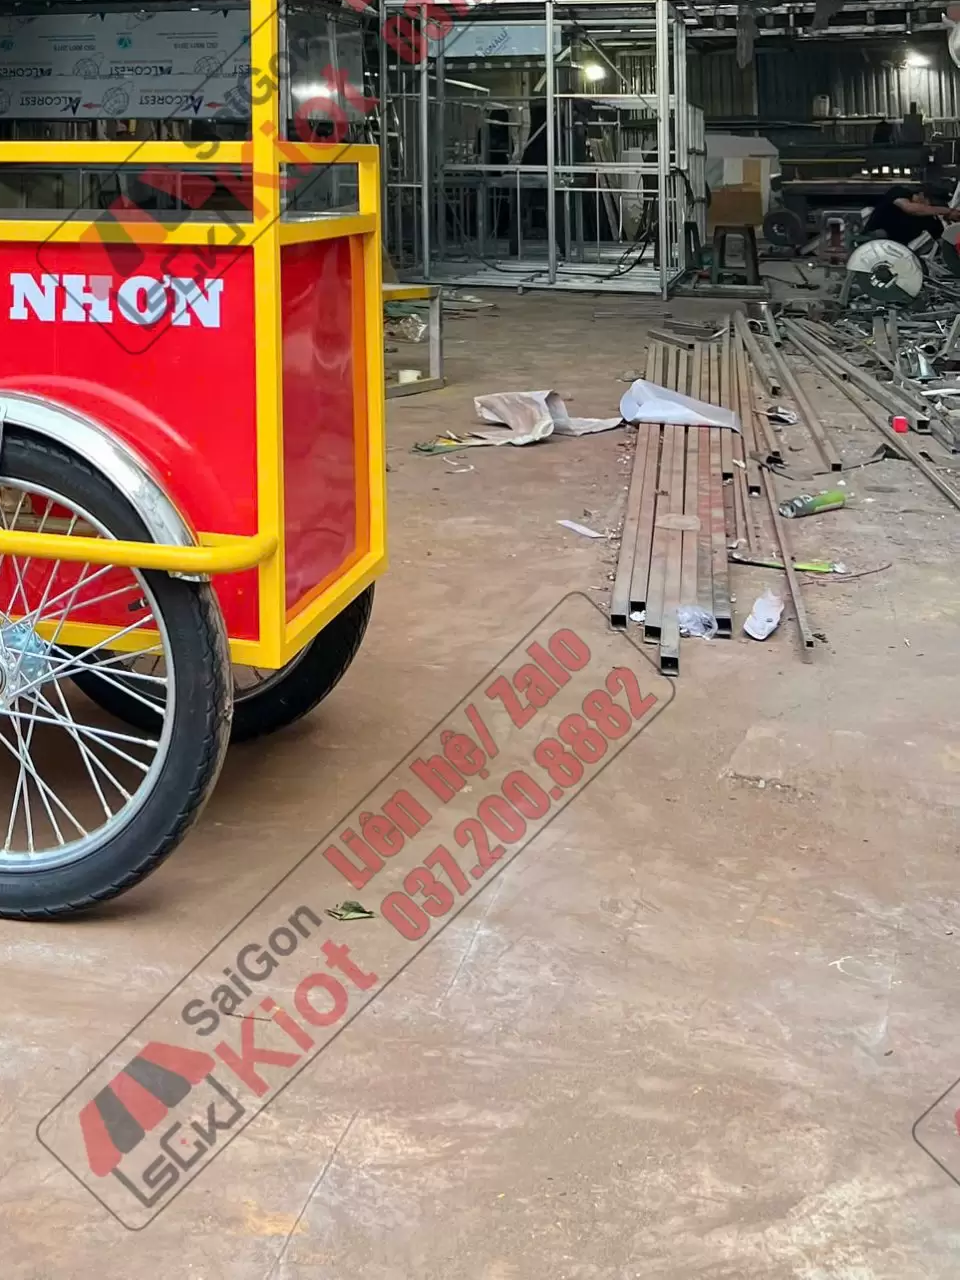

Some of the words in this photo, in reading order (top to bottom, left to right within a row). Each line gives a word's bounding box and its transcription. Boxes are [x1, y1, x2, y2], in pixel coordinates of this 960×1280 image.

[19, 96, 83, 116] ALCOREST
[139, 95, 204, 115] ALCOREST
[10, 273, 224, 328] NHƠN
